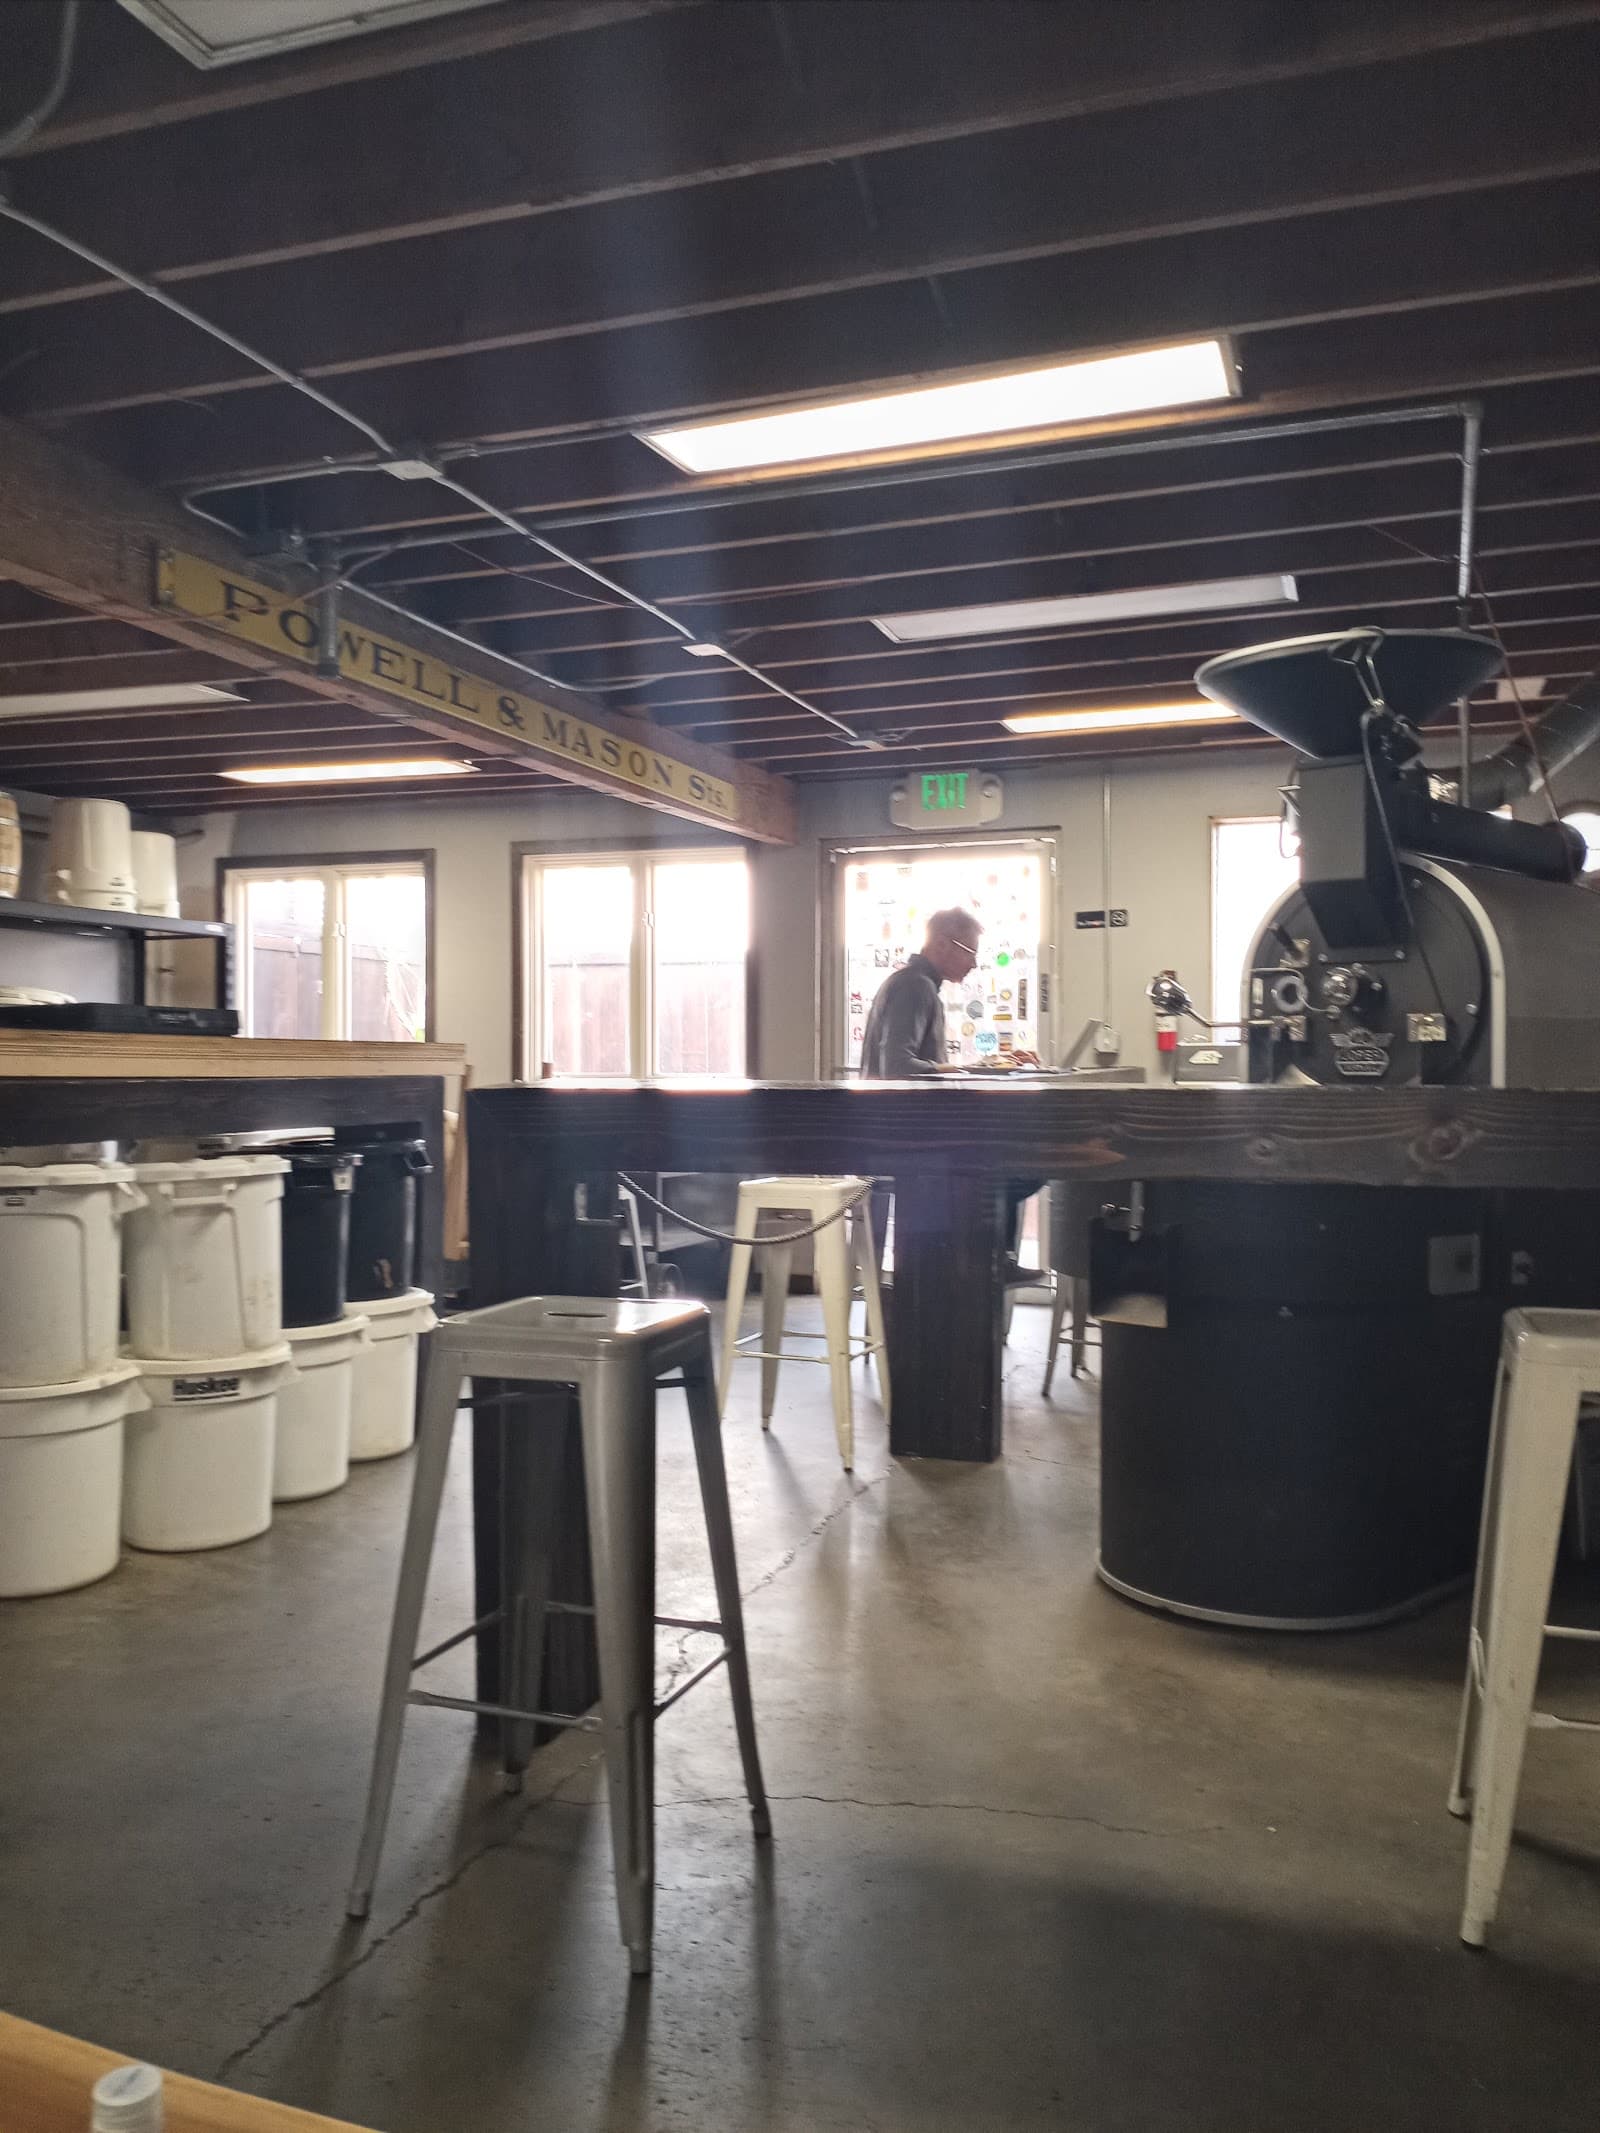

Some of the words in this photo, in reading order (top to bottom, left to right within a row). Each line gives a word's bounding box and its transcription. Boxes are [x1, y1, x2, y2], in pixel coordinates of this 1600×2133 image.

[220, 579, 480, 714] POWELL
[498, 695, 526, 731] &
[543, 711, 673, 788] MASON
[921, 772, 968, 811] EXIT
